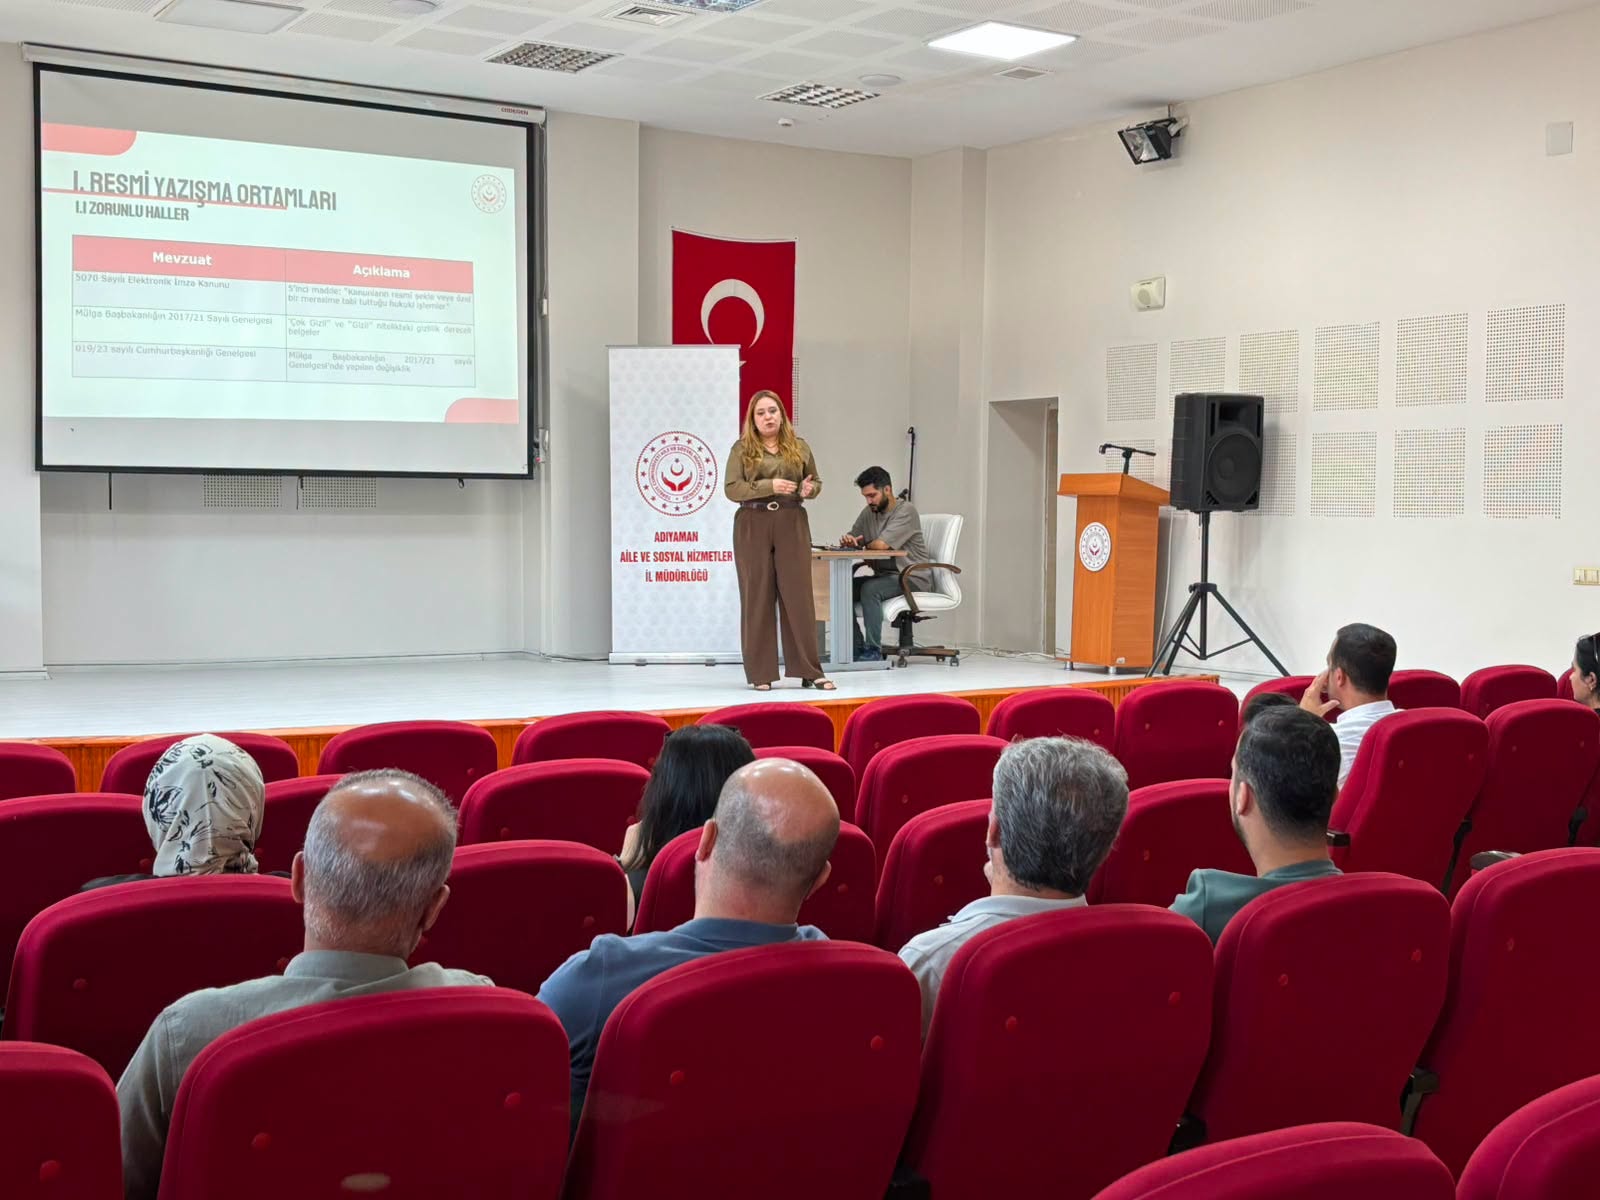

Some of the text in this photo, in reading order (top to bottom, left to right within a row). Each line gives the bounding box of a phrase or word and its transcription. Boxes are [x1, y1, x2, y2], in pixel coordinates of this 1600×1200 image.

[90, 170, 150, 196] RESMİ
[154, 176, 232, 207] YAZIŞMA
[237, 184, 337, 211] ORTAMLARI
[89, 201, 143, 218] ZORUNLU
[145, 206, 189, 221] HALLER
[152, 252, 212, 265] Mevzuat
[352, 264, 411, 278] Açıklama
[127, 276, 172, 286] Elektronik
[198, 279, 230, 289] Kanunu
[168, 312, 204, 323] 2017/21
[654, 531, 699, 543] ADIYAMAN
[620, 549, 733, 563] AİLE VE SOSYAL HİZMETLER
[645, 568, 709, 582] İL MÜDÜRLÜĞÜ
